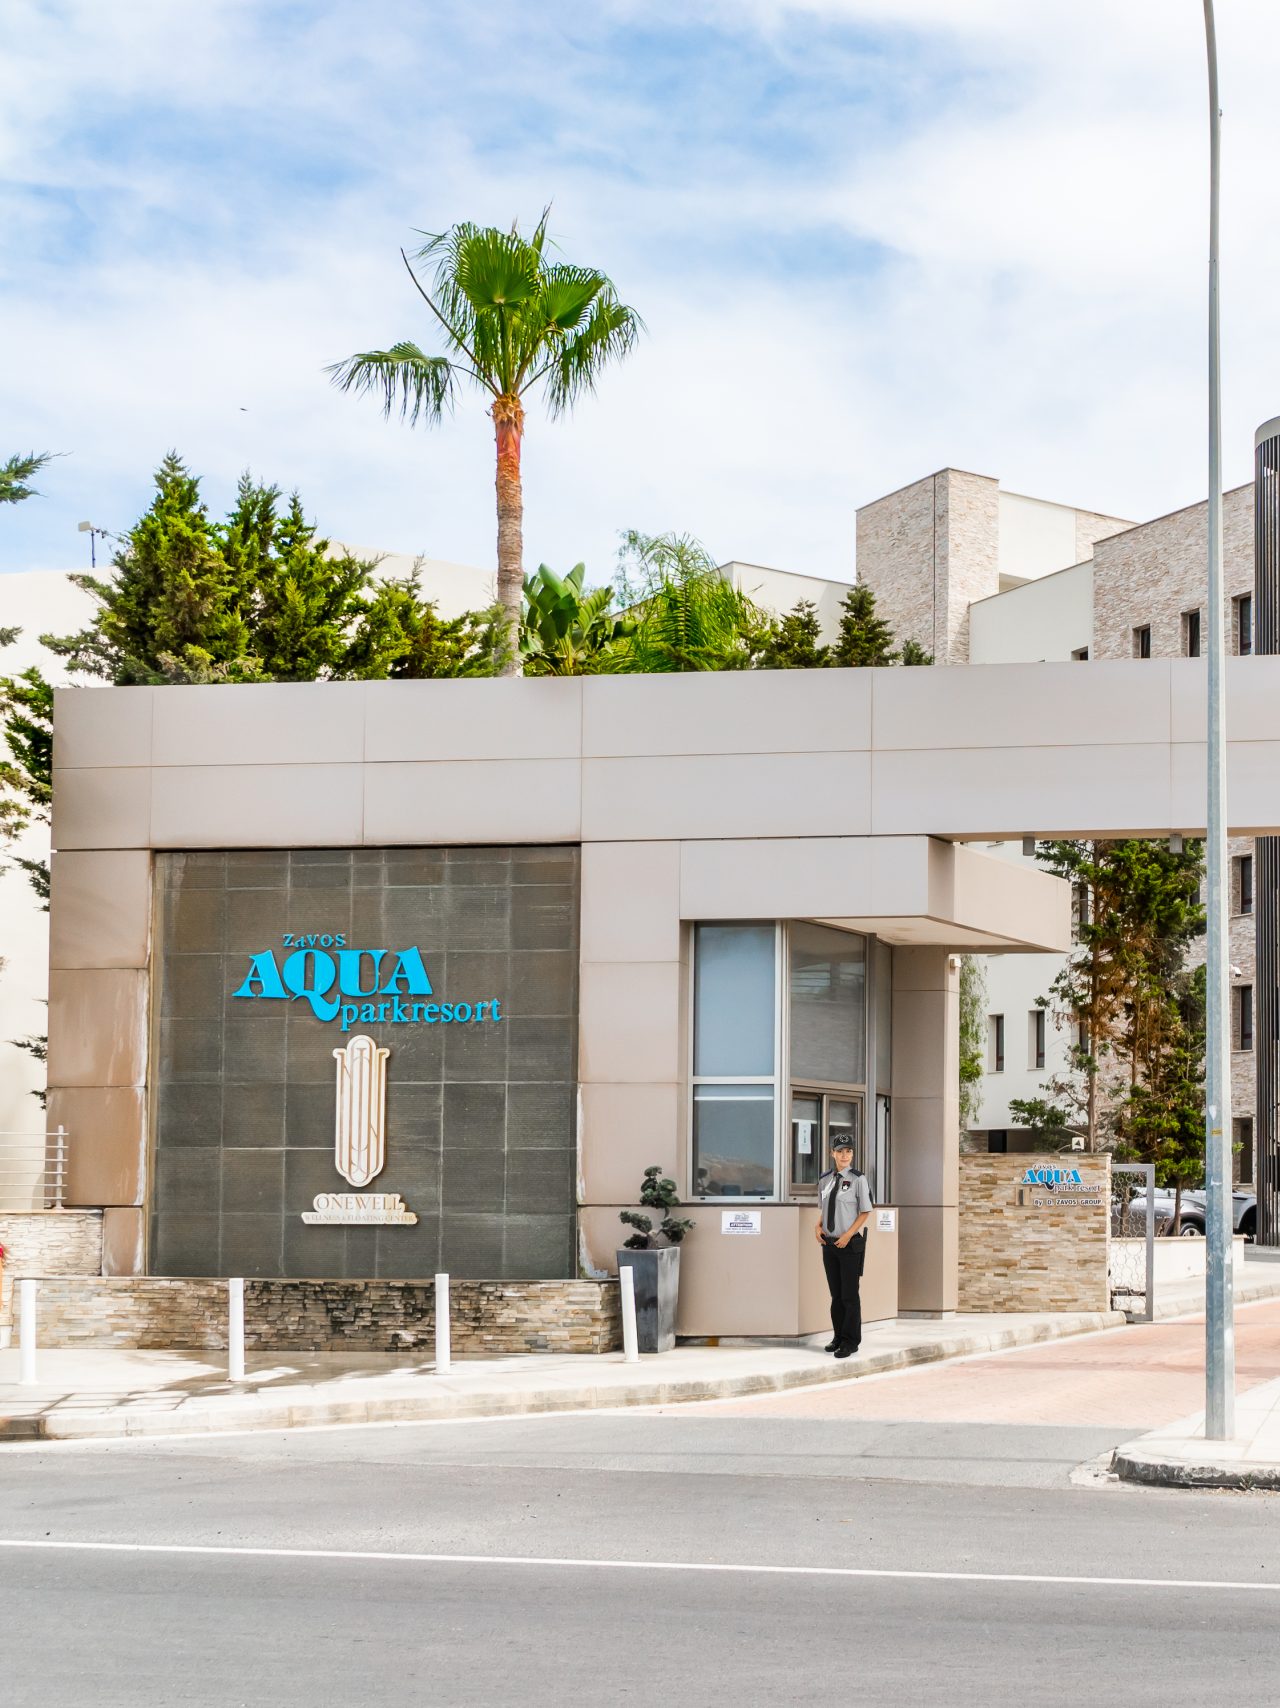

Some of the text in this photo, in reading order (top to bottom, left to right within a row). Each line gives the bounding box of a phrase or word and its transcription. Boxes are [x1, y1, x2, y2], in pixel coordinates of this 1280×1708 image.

[232, 946, 433, 1022] AQUA
[1022, 1169, 1083, 1191] AQUA
[316, 1196, 402, 1210] ONEWELL
